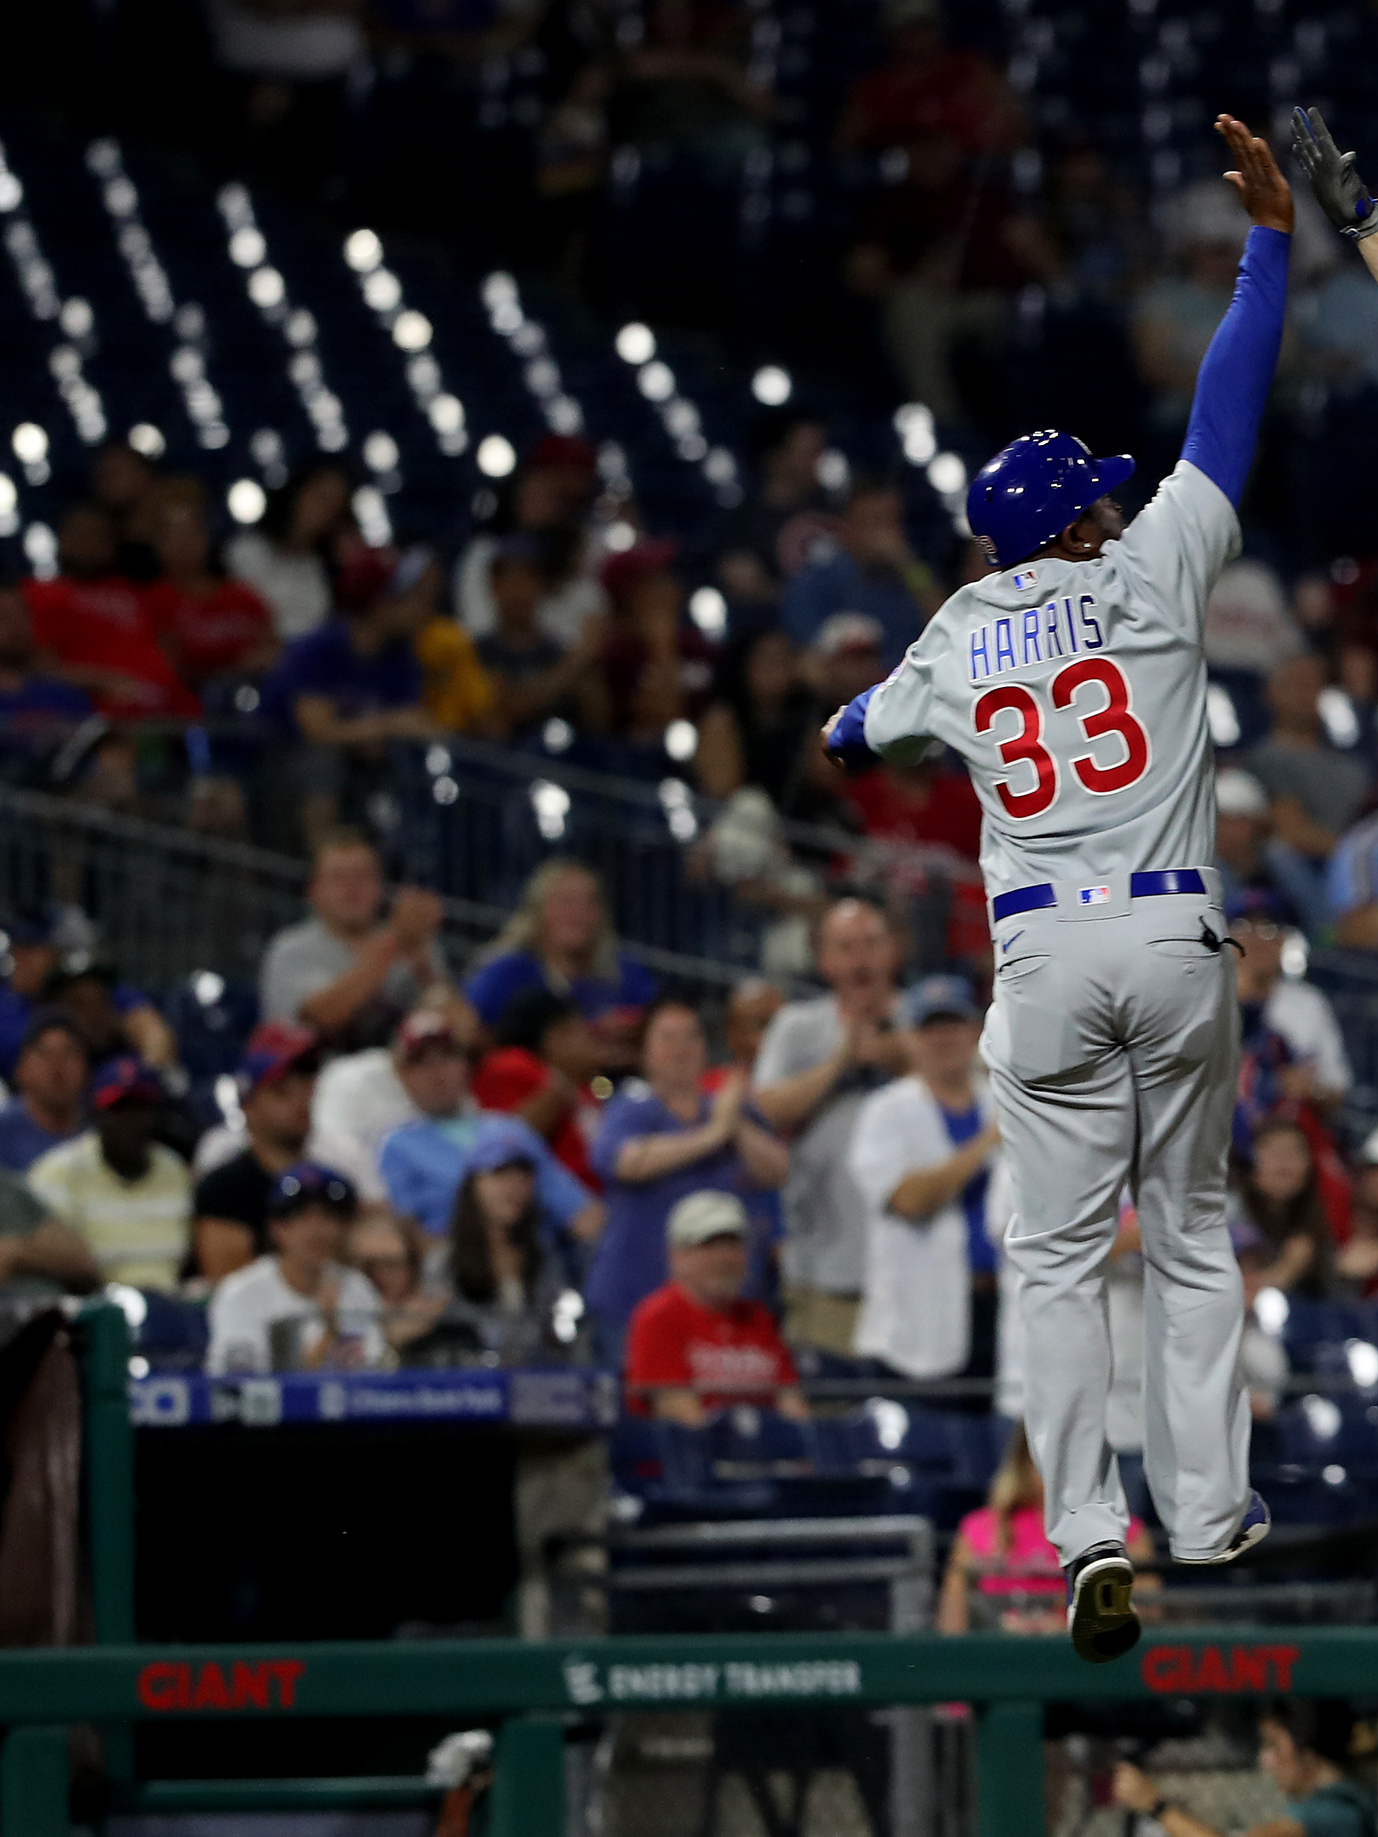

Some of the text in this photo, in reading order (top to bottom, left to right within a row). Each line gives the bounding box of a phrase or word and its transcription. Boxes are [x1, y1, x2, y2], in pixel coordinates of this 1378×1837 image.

[968, 594, 1106, 683] HARRIS
[973, 655, 1152, 822] 33
[137, 1660, 306, 1711] GIANT
[609, 1659, 860, 1699] ENERGY TRANSFER
[1142, 1644, 1300, 1694] GIANT
